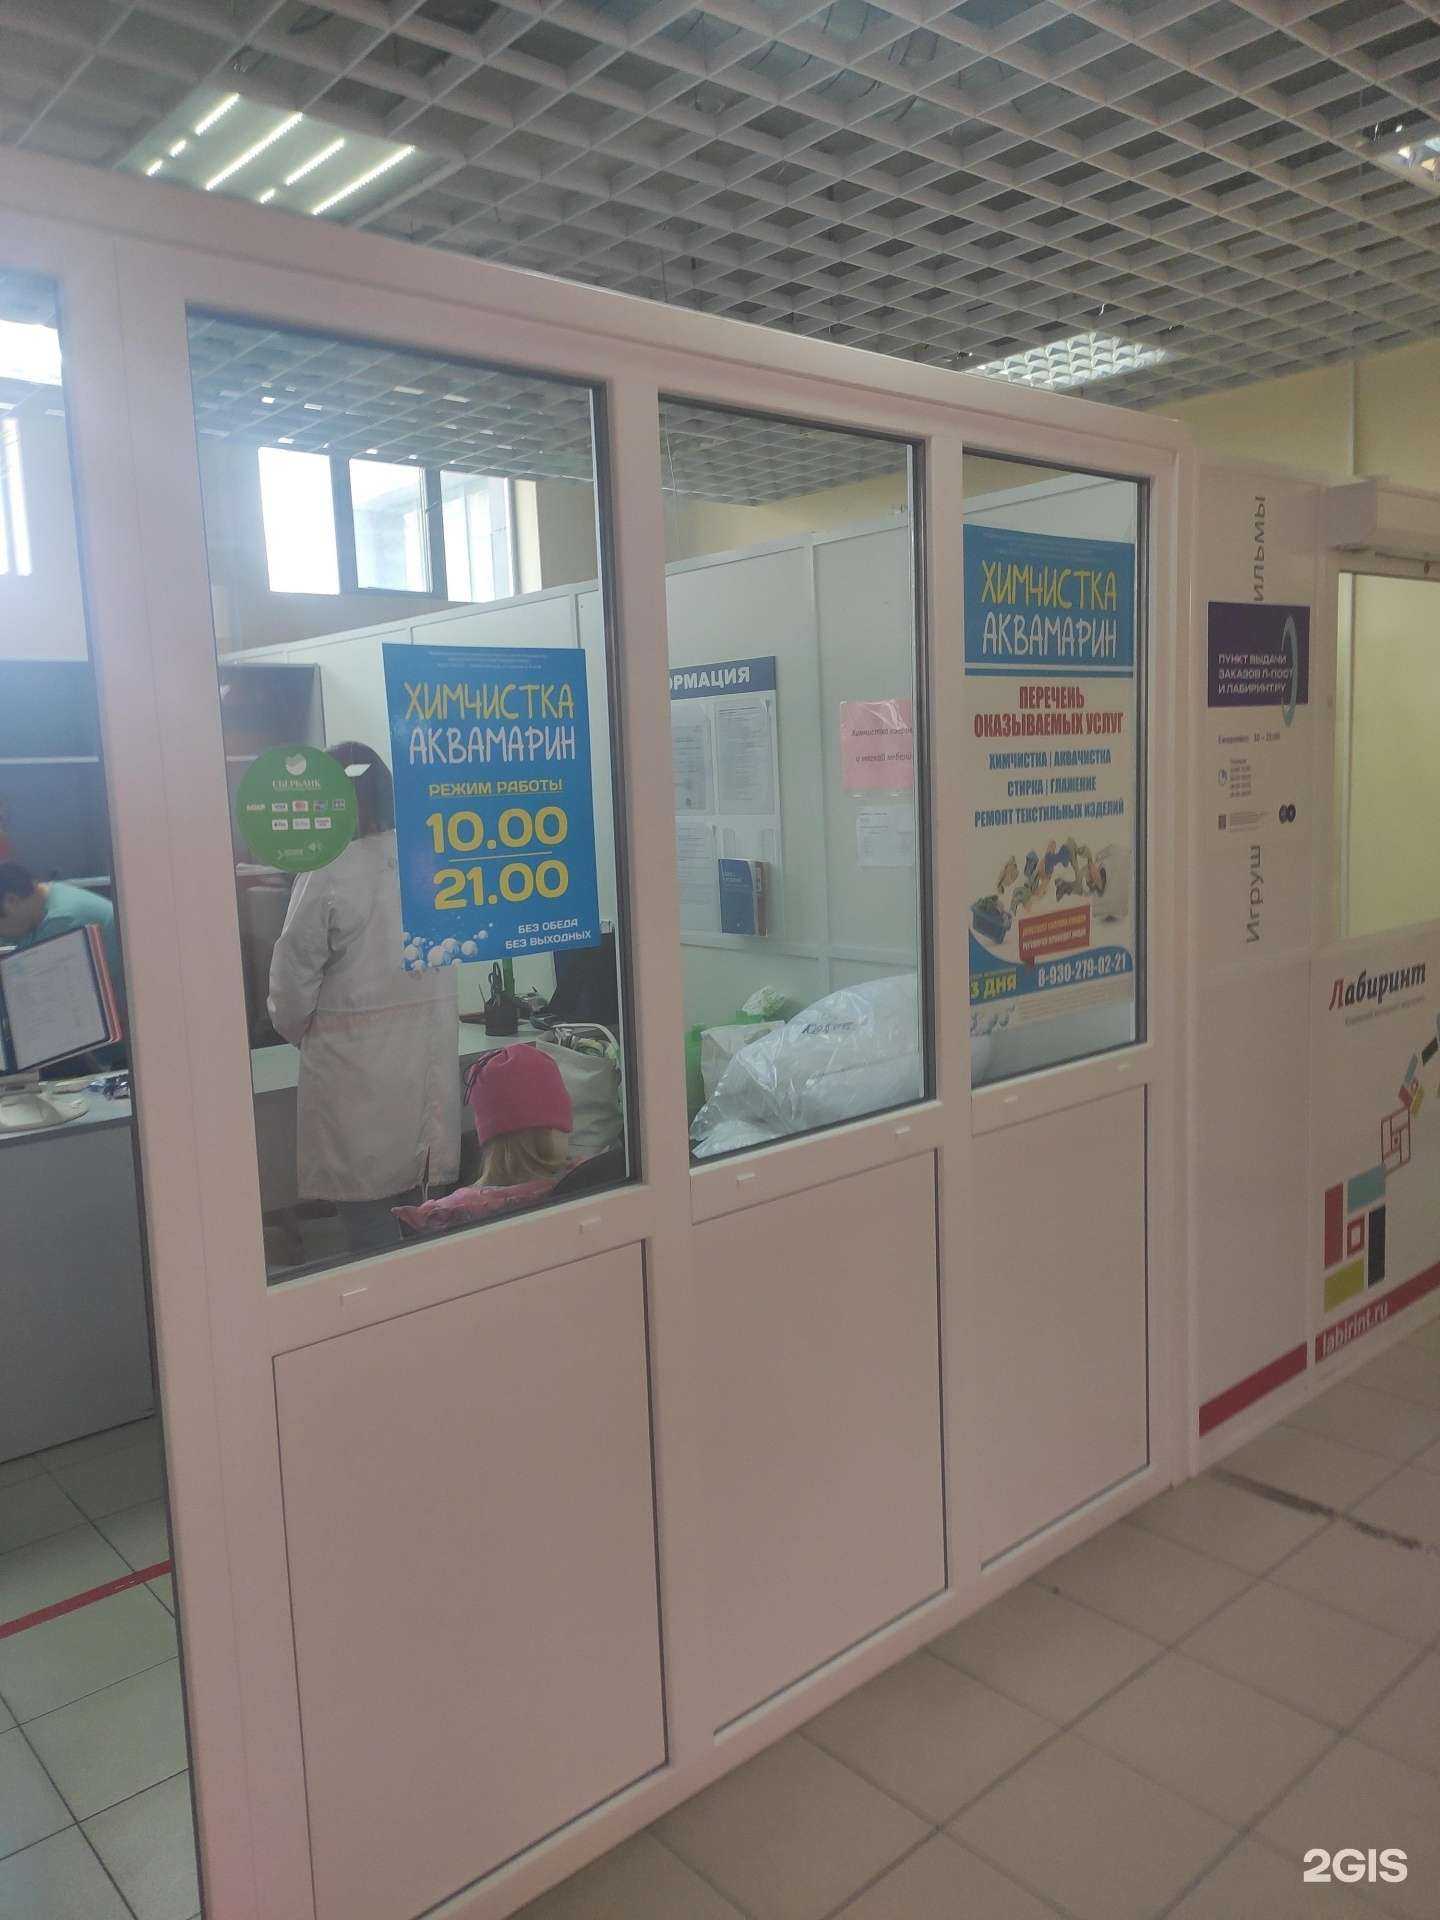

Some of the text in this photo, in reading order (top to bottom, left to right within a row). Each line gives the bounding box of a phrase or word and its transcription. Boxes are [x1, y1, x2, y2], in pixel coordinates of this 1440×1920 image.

[982, 560, 1117, 611] ХИМЧИСТКА
[982, 611, 1117, 658] АКВАМАРИН
[1219, 654, 1287, 665] ПУНКТ ВЫДАЧИ
[1219, 669, 1260, 679] ЗАКАЗОВ
[403, 681, 575, 721] ХИМЧИСТКА
[1019, 686, 1085, 710] ПЕРЕЧЕНЬ
[974, 712, 1124, 738] ОКАЗЫВАЕМЫХ УСЛУГ
[409, 725, 576, 765] АКВАМАРИН
[989, 749, 1111, 769] ХИМЧИСТКА АКВАЧИСТКА
[429, 778, 564, 797] РЕЖИМ РАБОТЫ
[1008, 776, 1096, 797] СТИРКА ГЛАЖЕНИЕ
[975, 798, 1124, 828] РЕМОНТ ТЕКСТИЛЬНЫХ ИЗДЕЛИЙ
[425, 806, 568, 854] 10.00
[433, 859, 569, 911] 21.00
[505, 930, 591, 950] БЕЗ ВЫХОДНЫХ
[518, 918, 578, 934] БЕЗ ОБЕДА
[1039, 952, 1126, 987] 8-930-279-02-21
[984, 976, 1017, 999] ДНЯ
[1329, 963, 1425, 1011] Лабиринт
[1322, 1300, 1388, 1356] labirint.ru
